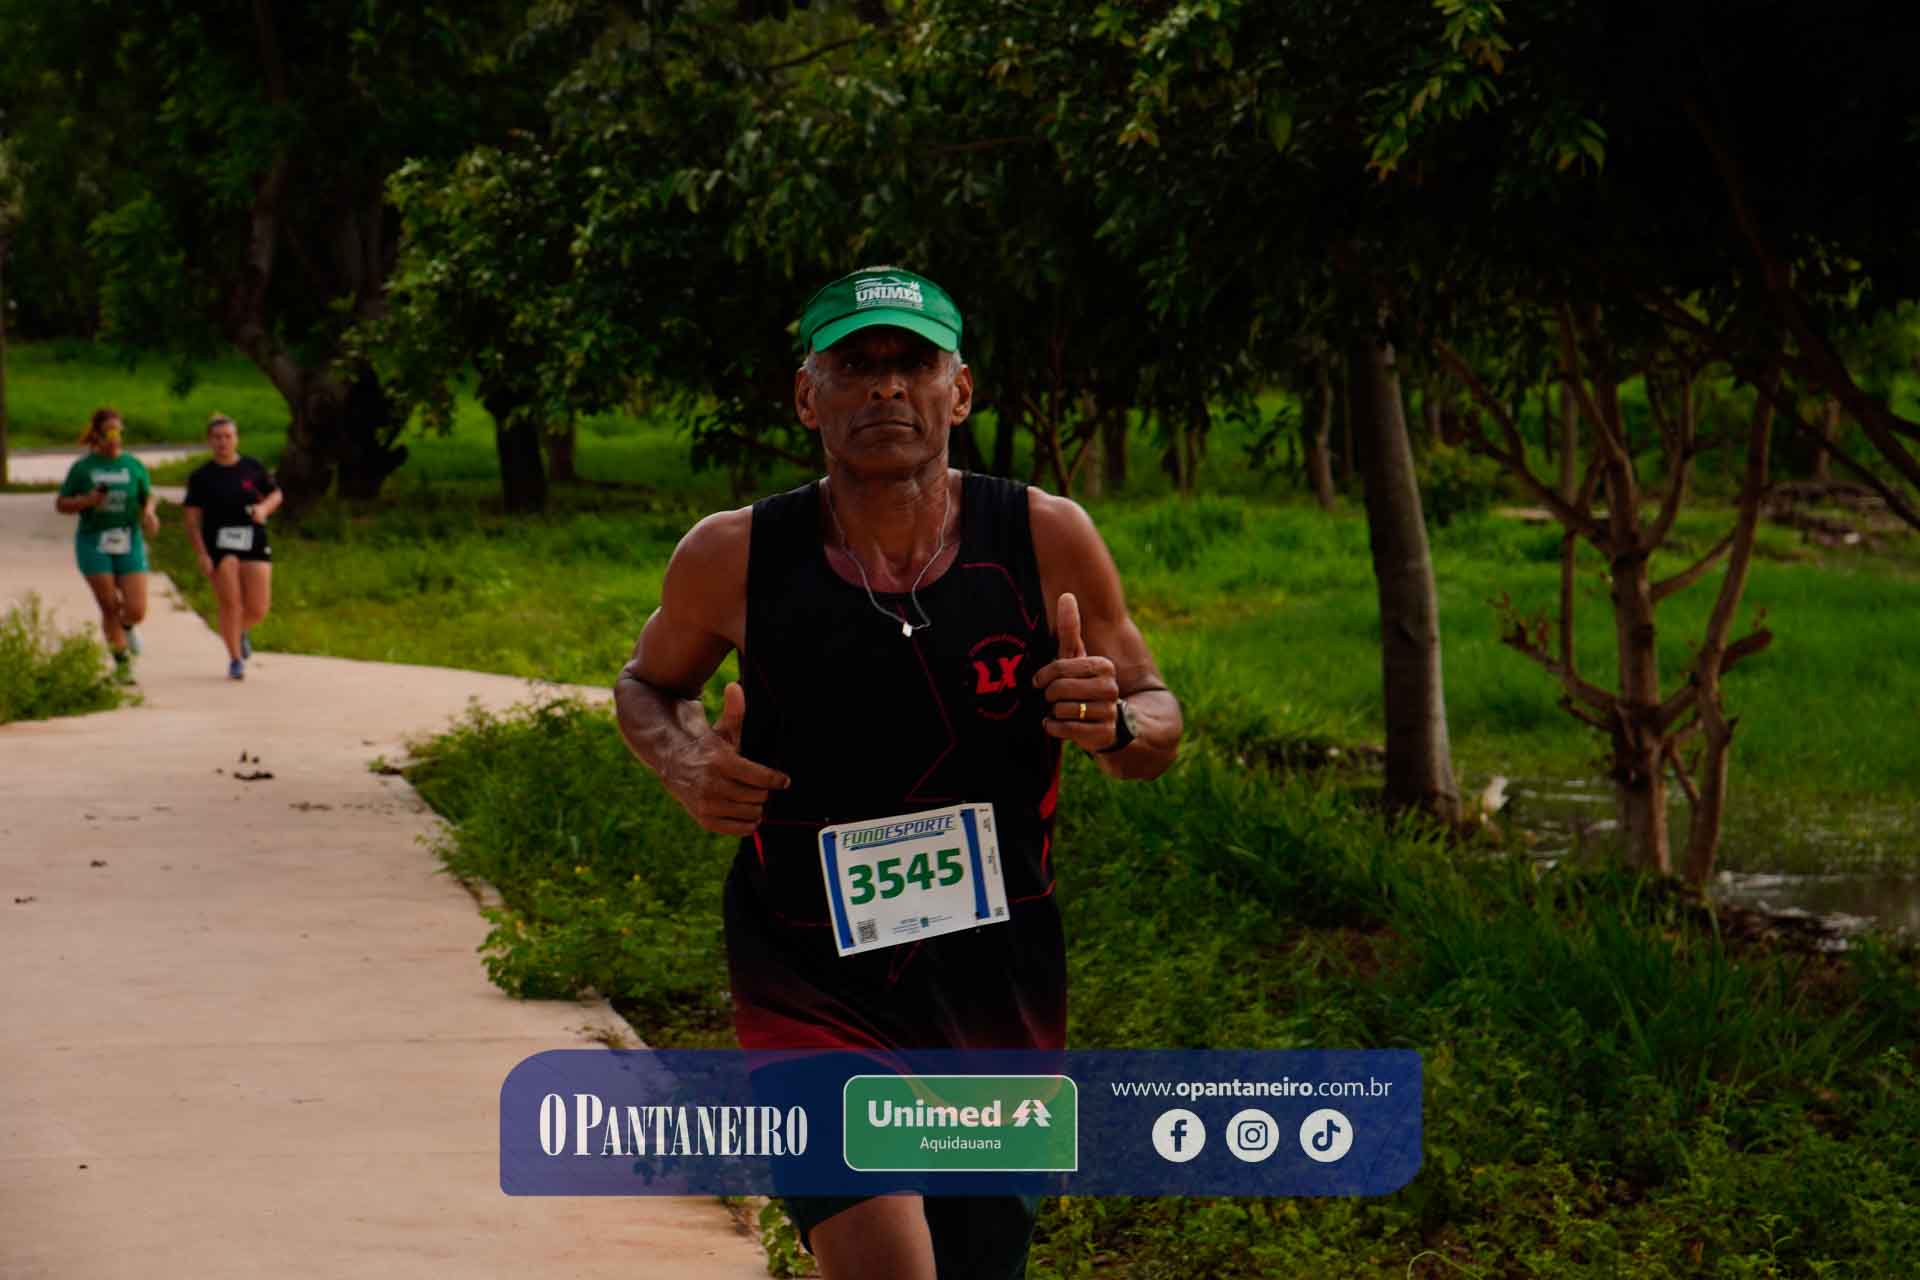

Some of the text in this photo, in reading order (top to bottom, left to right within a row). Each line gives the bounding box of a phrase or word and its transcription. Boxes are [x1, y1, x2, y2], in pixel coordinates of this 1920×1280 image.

[856, 286, 923, 304] UNIMED
[842, 815, 955, 848] FUNDESPORTE
[847, 847, 965, 906] 3545
